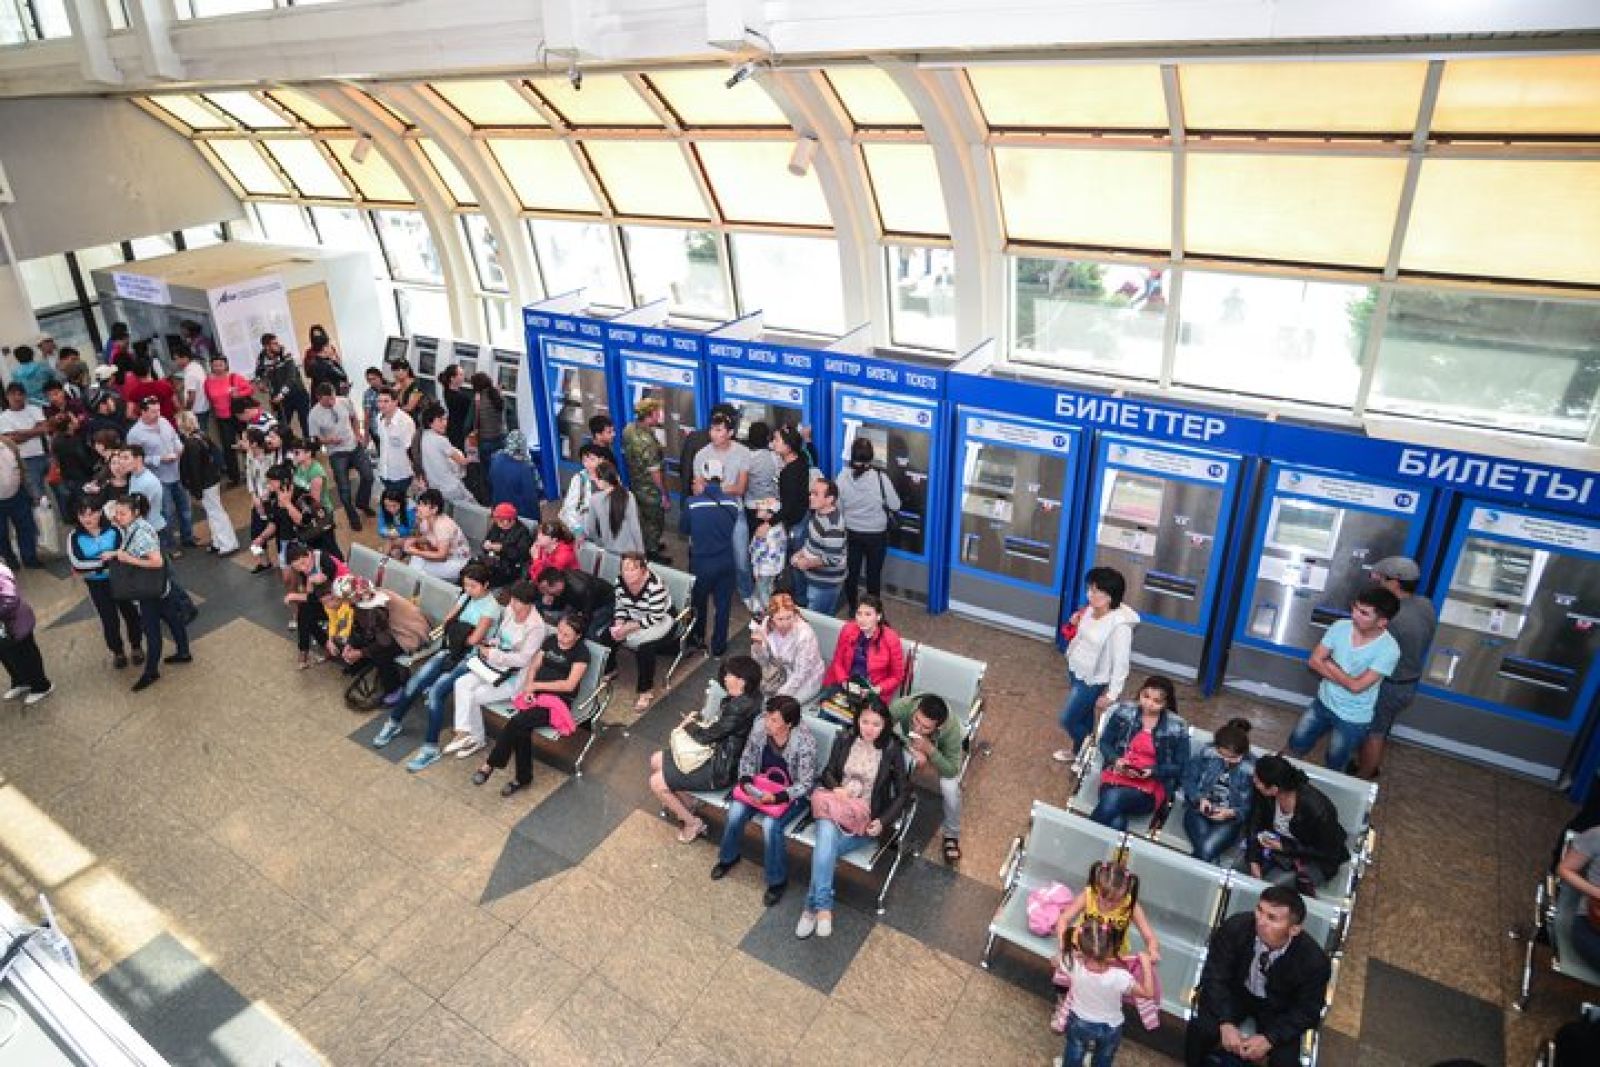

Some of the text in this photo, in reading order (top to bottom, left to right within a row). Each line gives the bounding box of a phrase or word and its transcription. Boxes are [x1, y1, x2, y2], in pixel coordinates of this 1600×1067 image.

[824, 358, 937, 390] БИЛЕТТЕР БИЛЕТЫ TICKETS
[1055, 393, 1226, 441] БИЛЕТТЕР
[1399, 448, 1594, 504] БИЛЕТЫ
